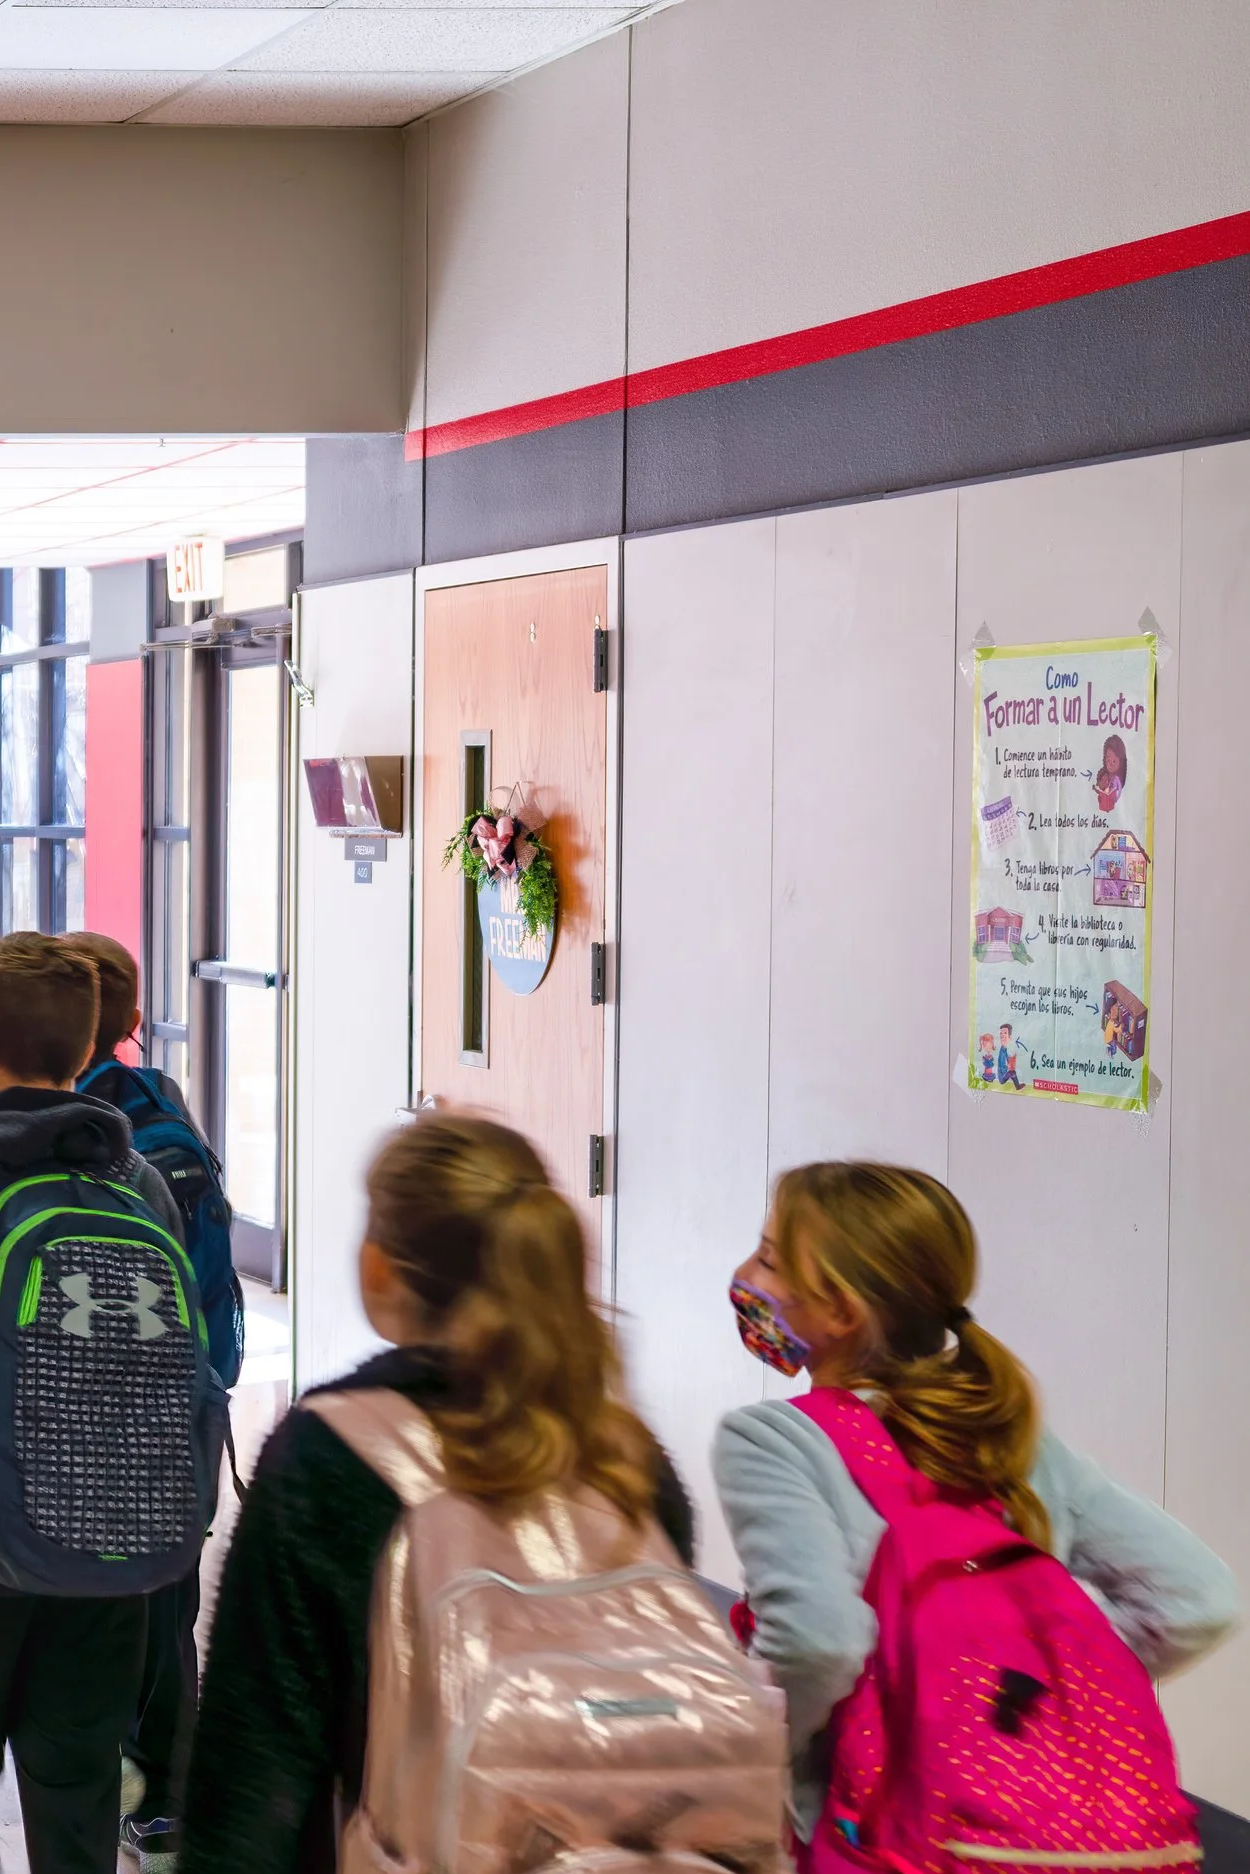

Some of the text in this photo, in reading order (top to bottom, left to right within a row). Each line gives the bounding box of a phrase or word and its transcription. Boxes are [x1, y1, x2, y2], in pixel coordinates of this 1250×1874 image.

[173, 543, 203, 593] EXIT
[1046, 665, 1079, 690] Como
[983, 681, 1145, 737] Formar a un Lector
[995, 746, 1001, 765] 1.
[1003, 748, 1035, 761] Comience
[1037, 751, 1047, 761] un
[1003, 763, 1077, 782] de lectura temprano.
[1028, 812, 1037, 830] 2.
[1039, 813, 1052, 828] Lea
[1054, 812, 1075, 828] todos
[1077, 814, 1088, 828] los
[1004, 858, 1074, 880] 3. Tenga libros por
[1015, 875, 1031, 891] toda
[1033, 877, 1040, 891] la
[1038, 914, 1046, 933] 4.
[1071, 914, 1078, 929] la
[1080, 914, 1116, 931] biblioteca
[1118, 921, 1123, 931] o
[1076, 936, 1089, 946] con
[1091, 934, 1136, 952] regularidad.
[1000, 977, 1088, 1004] 5. Permita que sus hijos
[1010, 998, 1036, 1016] escojan
[1038, 999, 1049, 1013] los
[1030, 1050, 1135, 1079] 6. Sea un ejemplo de lector.
[1039, 1081, 1078, 1093] SCHOLASTIC
